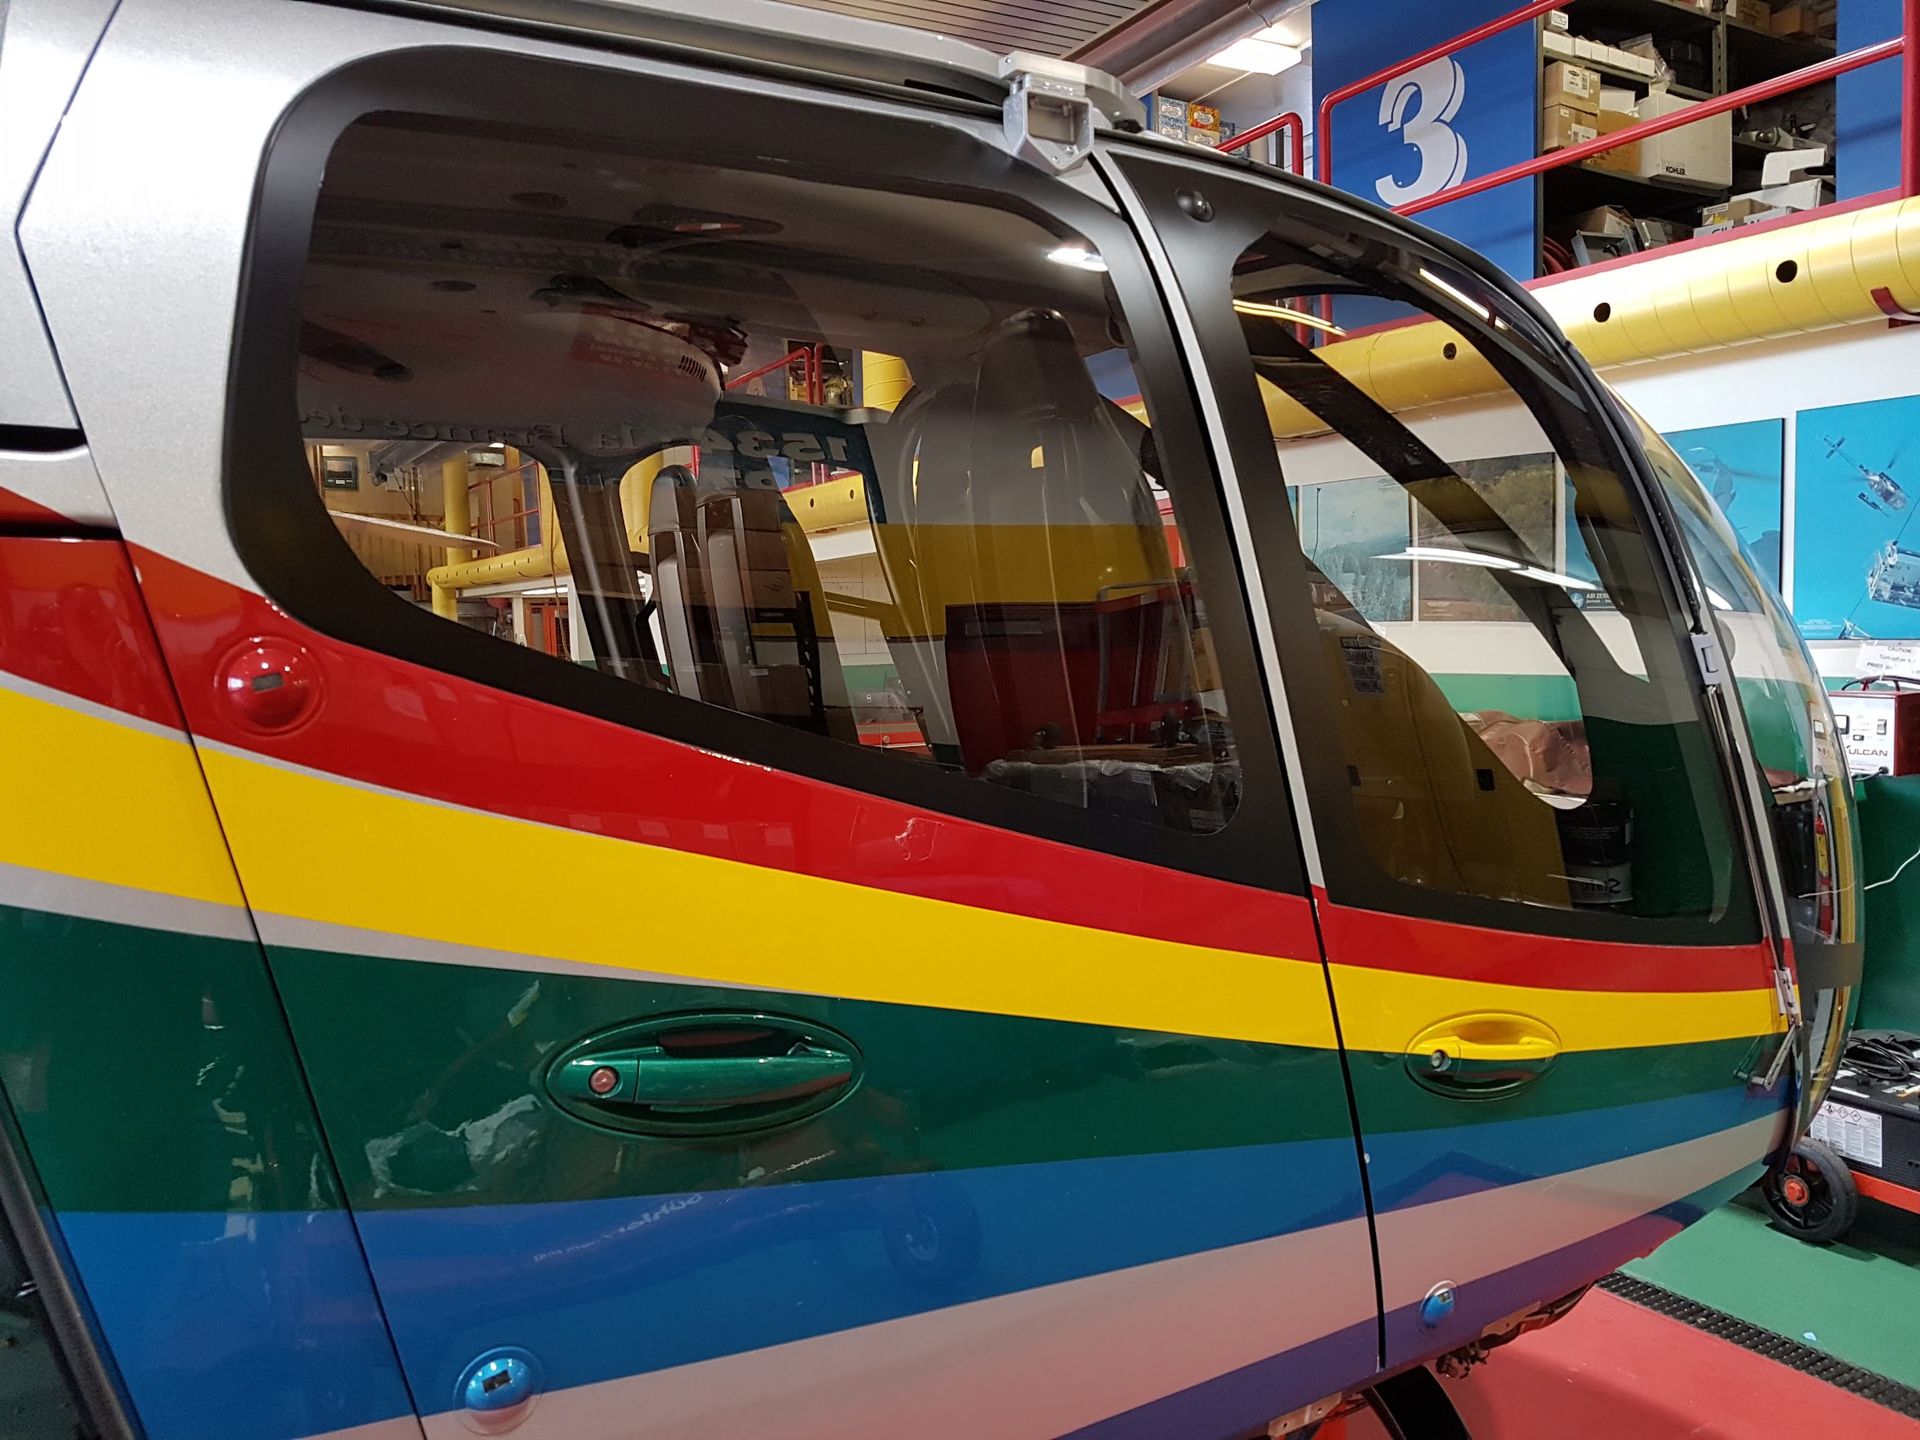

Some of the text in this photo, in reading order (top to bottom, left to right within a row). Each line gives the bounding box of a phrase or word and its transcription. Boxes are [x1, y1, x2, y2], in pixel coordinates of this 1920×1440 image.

[1375, 56, 1468, 207] 3
[1666, 165, 1687, 176] KOHLER
[1888, 645, 1912, 653] CAUTION
